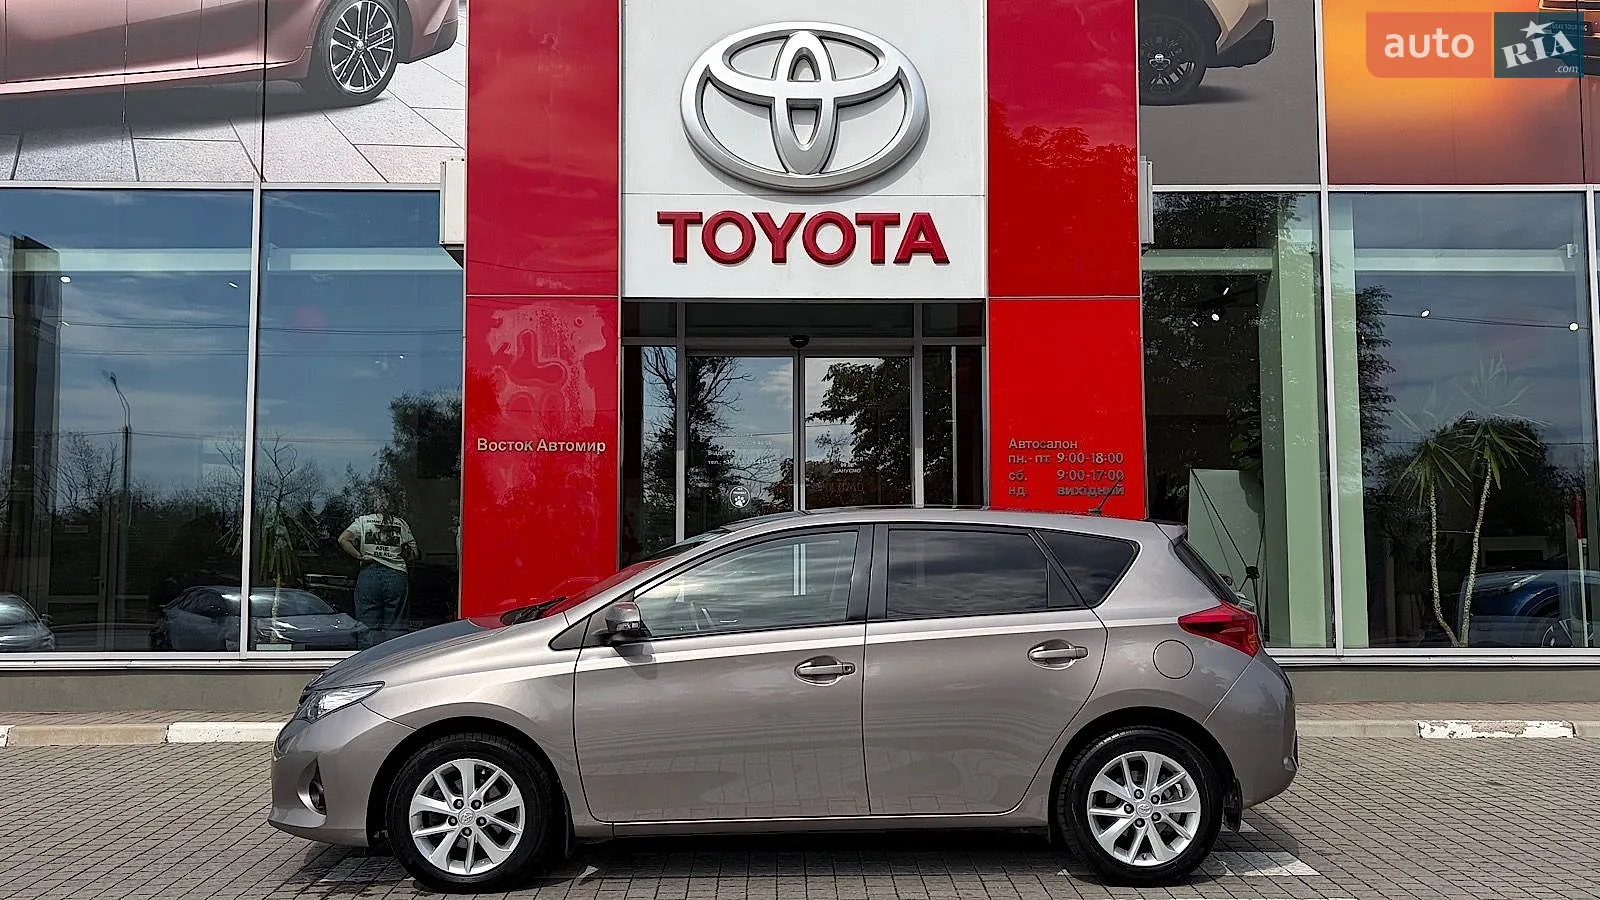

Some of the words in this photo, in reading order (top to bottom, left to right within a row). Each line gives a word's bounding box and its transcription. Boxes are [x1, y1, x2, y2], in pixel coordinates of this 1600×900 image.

[657, 210, 950, 265] TOYOTA
[477, 437, 533, 452] Восток
[536, 438, 606, 455] Автомир
[1008, 438, 1078, 449] Автосалон
[1057, 452, 1124, 464] 9:00-18:00
[1008, 469, 1028, 481] сб.
[1057, 469, 1124, 481] 9:00-17:00
